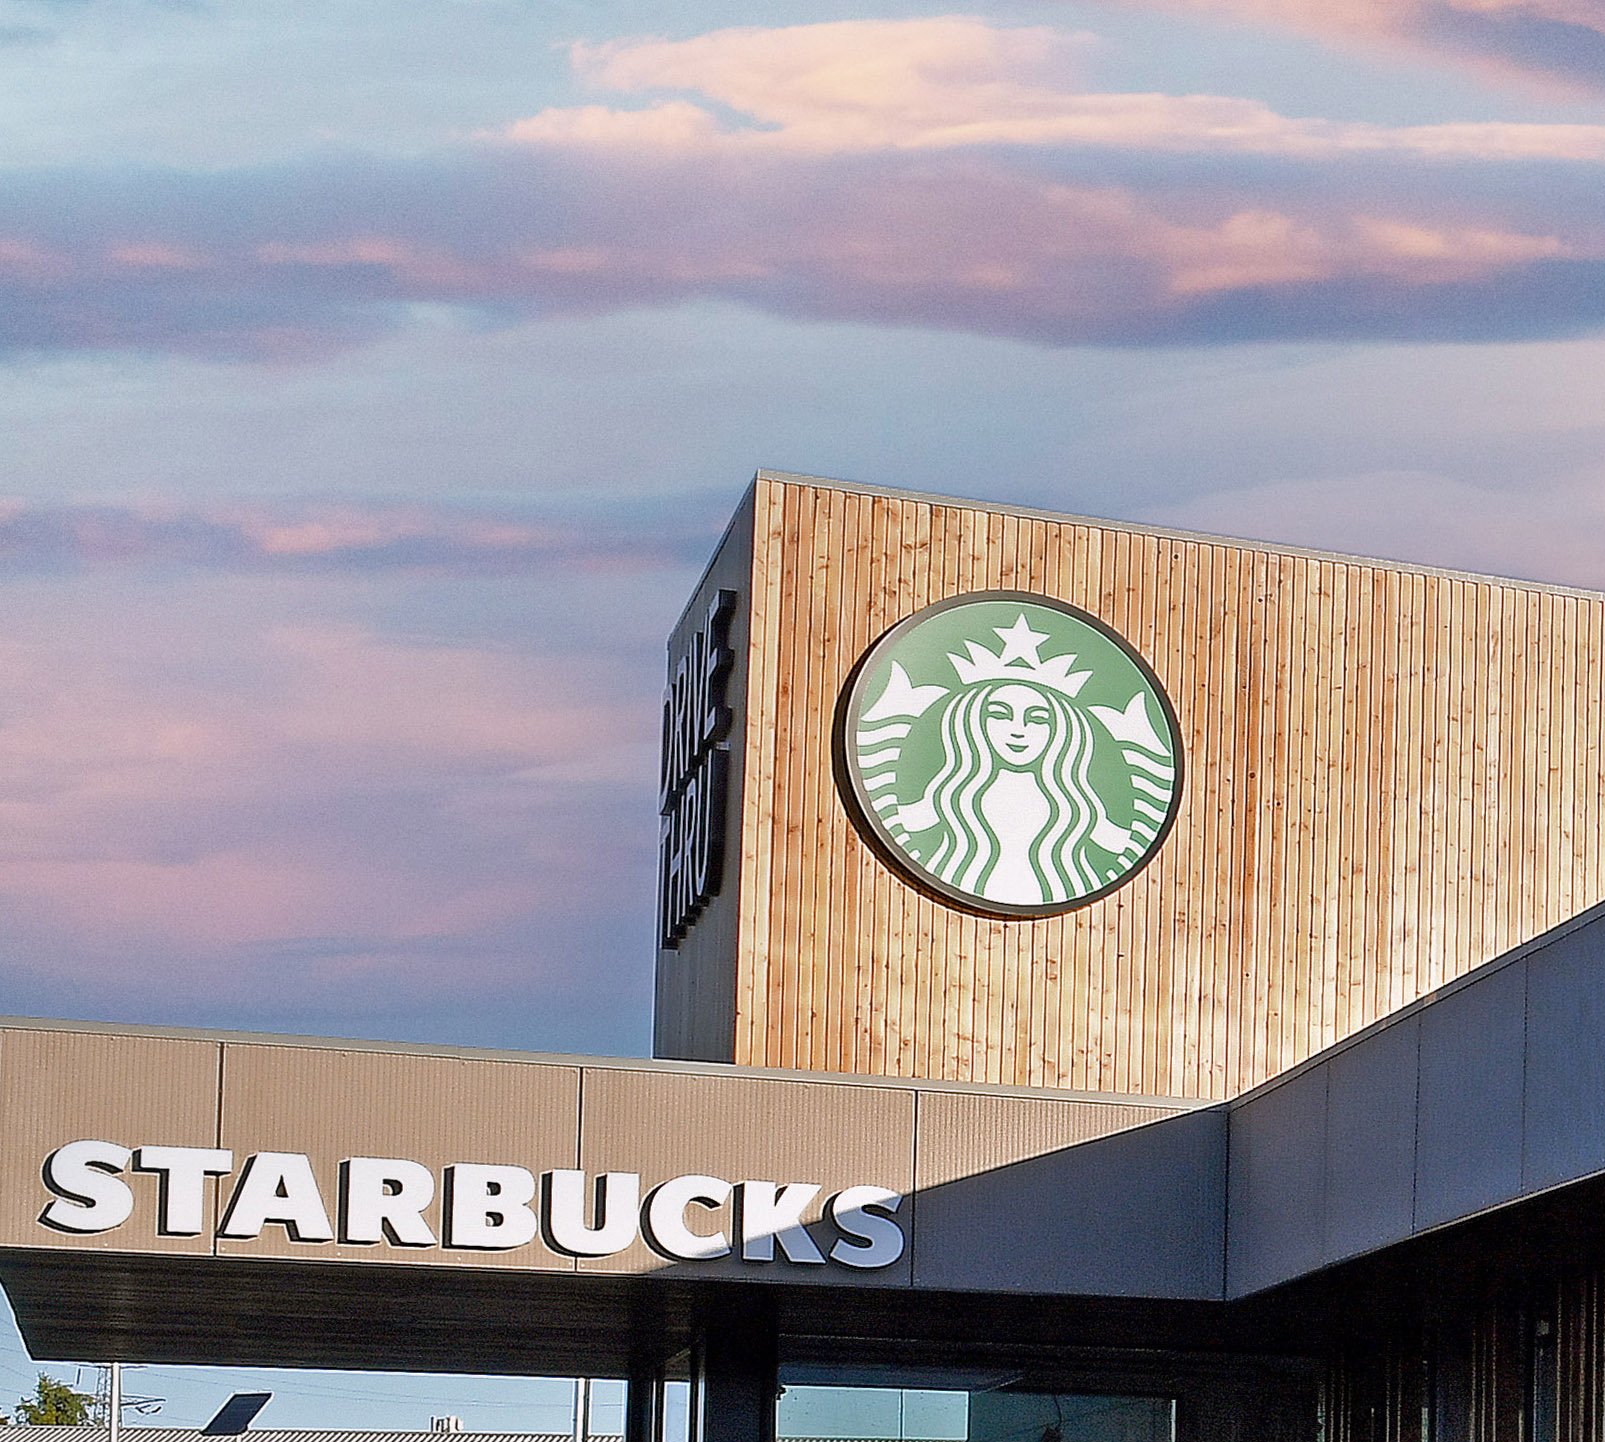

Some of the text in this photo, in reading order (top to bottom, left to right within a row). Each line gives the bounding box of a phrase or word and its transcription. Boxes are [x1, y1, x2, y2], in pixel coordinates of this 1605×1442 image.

[659, 588, 730, 817] DRIVE
[658, 747, 722, 950] THRU
[37, 1139, 907, 1269] STARBUCKS
